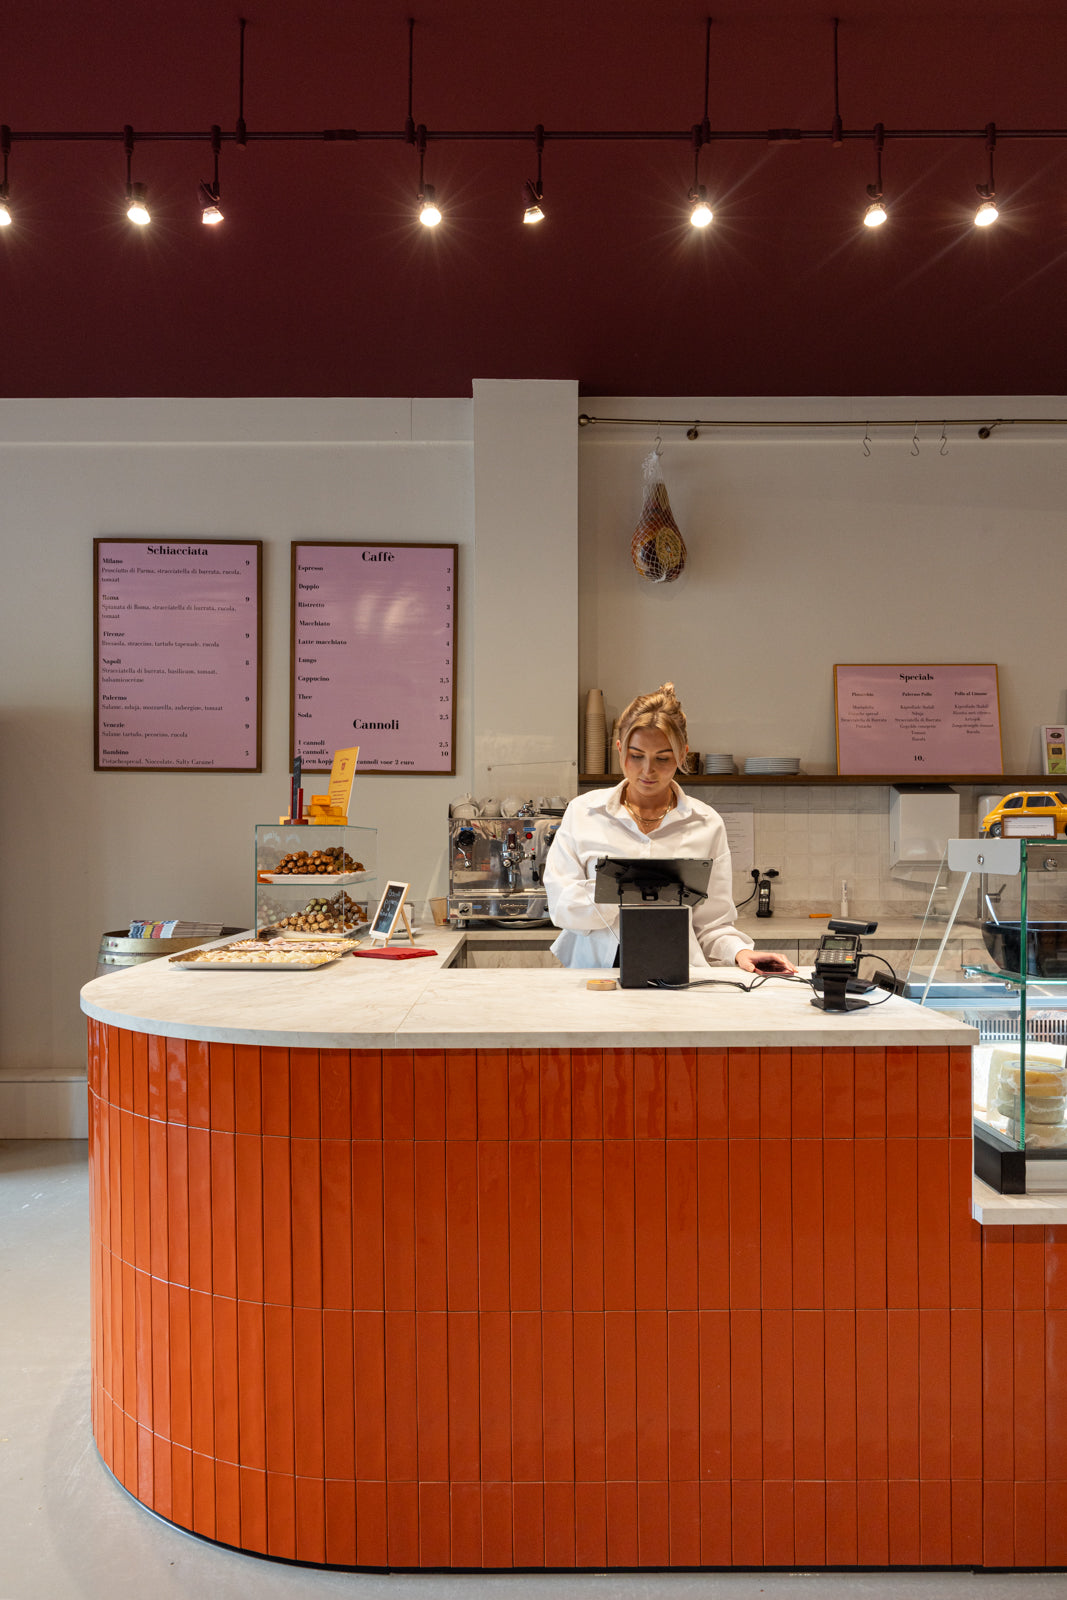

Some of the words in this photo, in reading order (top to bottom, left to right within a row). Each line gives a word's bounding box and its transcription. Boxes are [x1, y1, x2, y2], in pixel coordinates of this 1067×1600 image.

[147, 545, 208, 556] Schiacciata
[362, 551, 395, 562] Caffè
[298, 675, 330, 683] Cappucino
[899, 673, 934, 682] Specials
[353, 719, 399, 730] Cannoli
